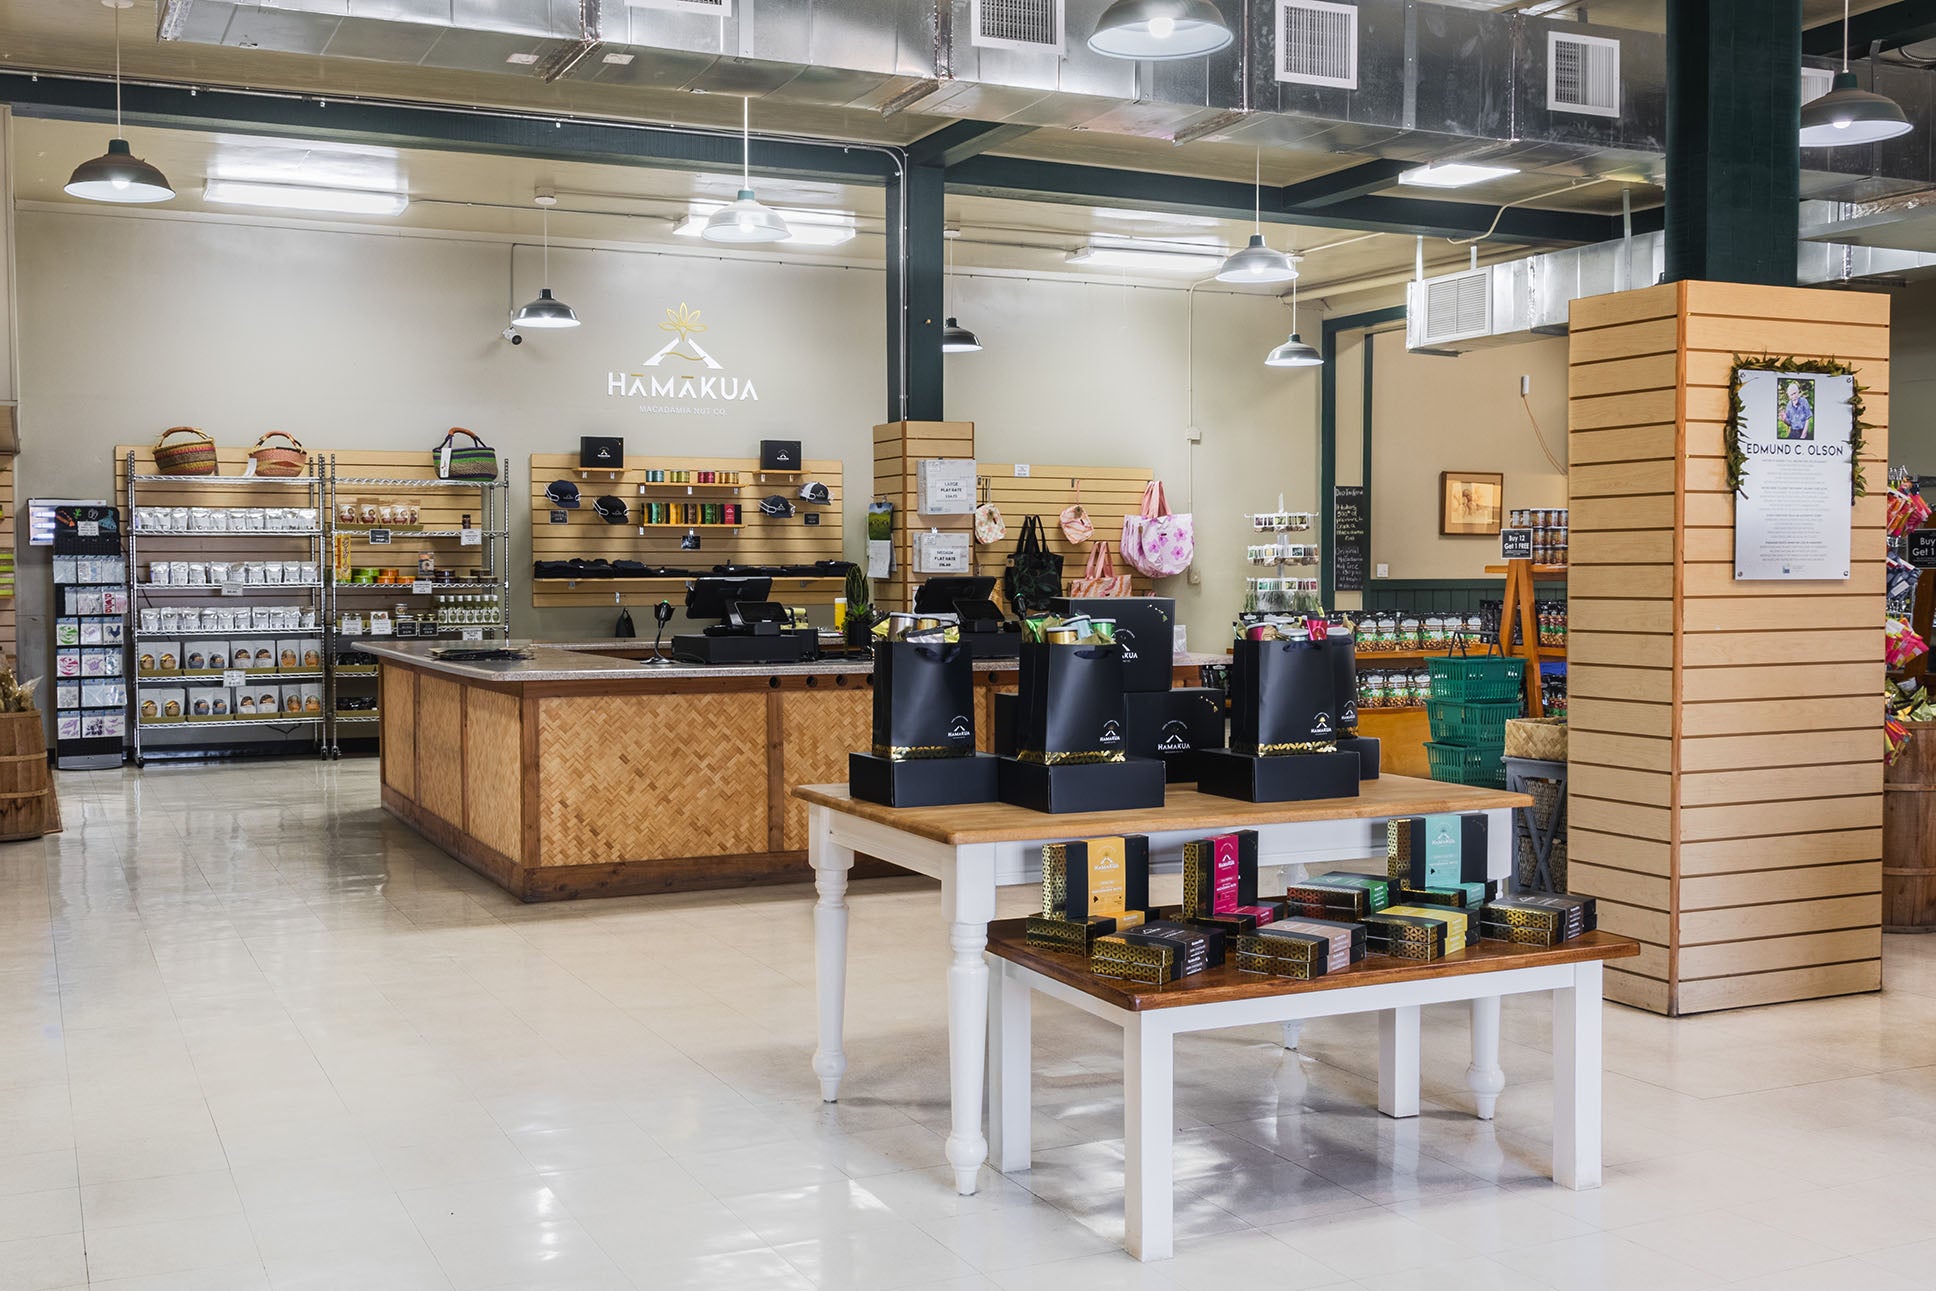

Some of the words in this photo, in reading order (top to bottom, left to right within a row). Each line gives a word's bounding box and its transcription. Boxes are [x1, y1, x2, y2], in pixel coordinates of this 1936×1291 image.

[608, 372, 758, 401] HĀMĀKUA
[640, 405, 691, 415] MACADAMIA
[693, 407, 711, 416] NUT
[1746, 443, 1791, 455] EDMUND
[1807, 445, 1843, 456] OLSON
[1920, 537, 1936, 546] Buy
[1912, 548, 1928, 556] Get
